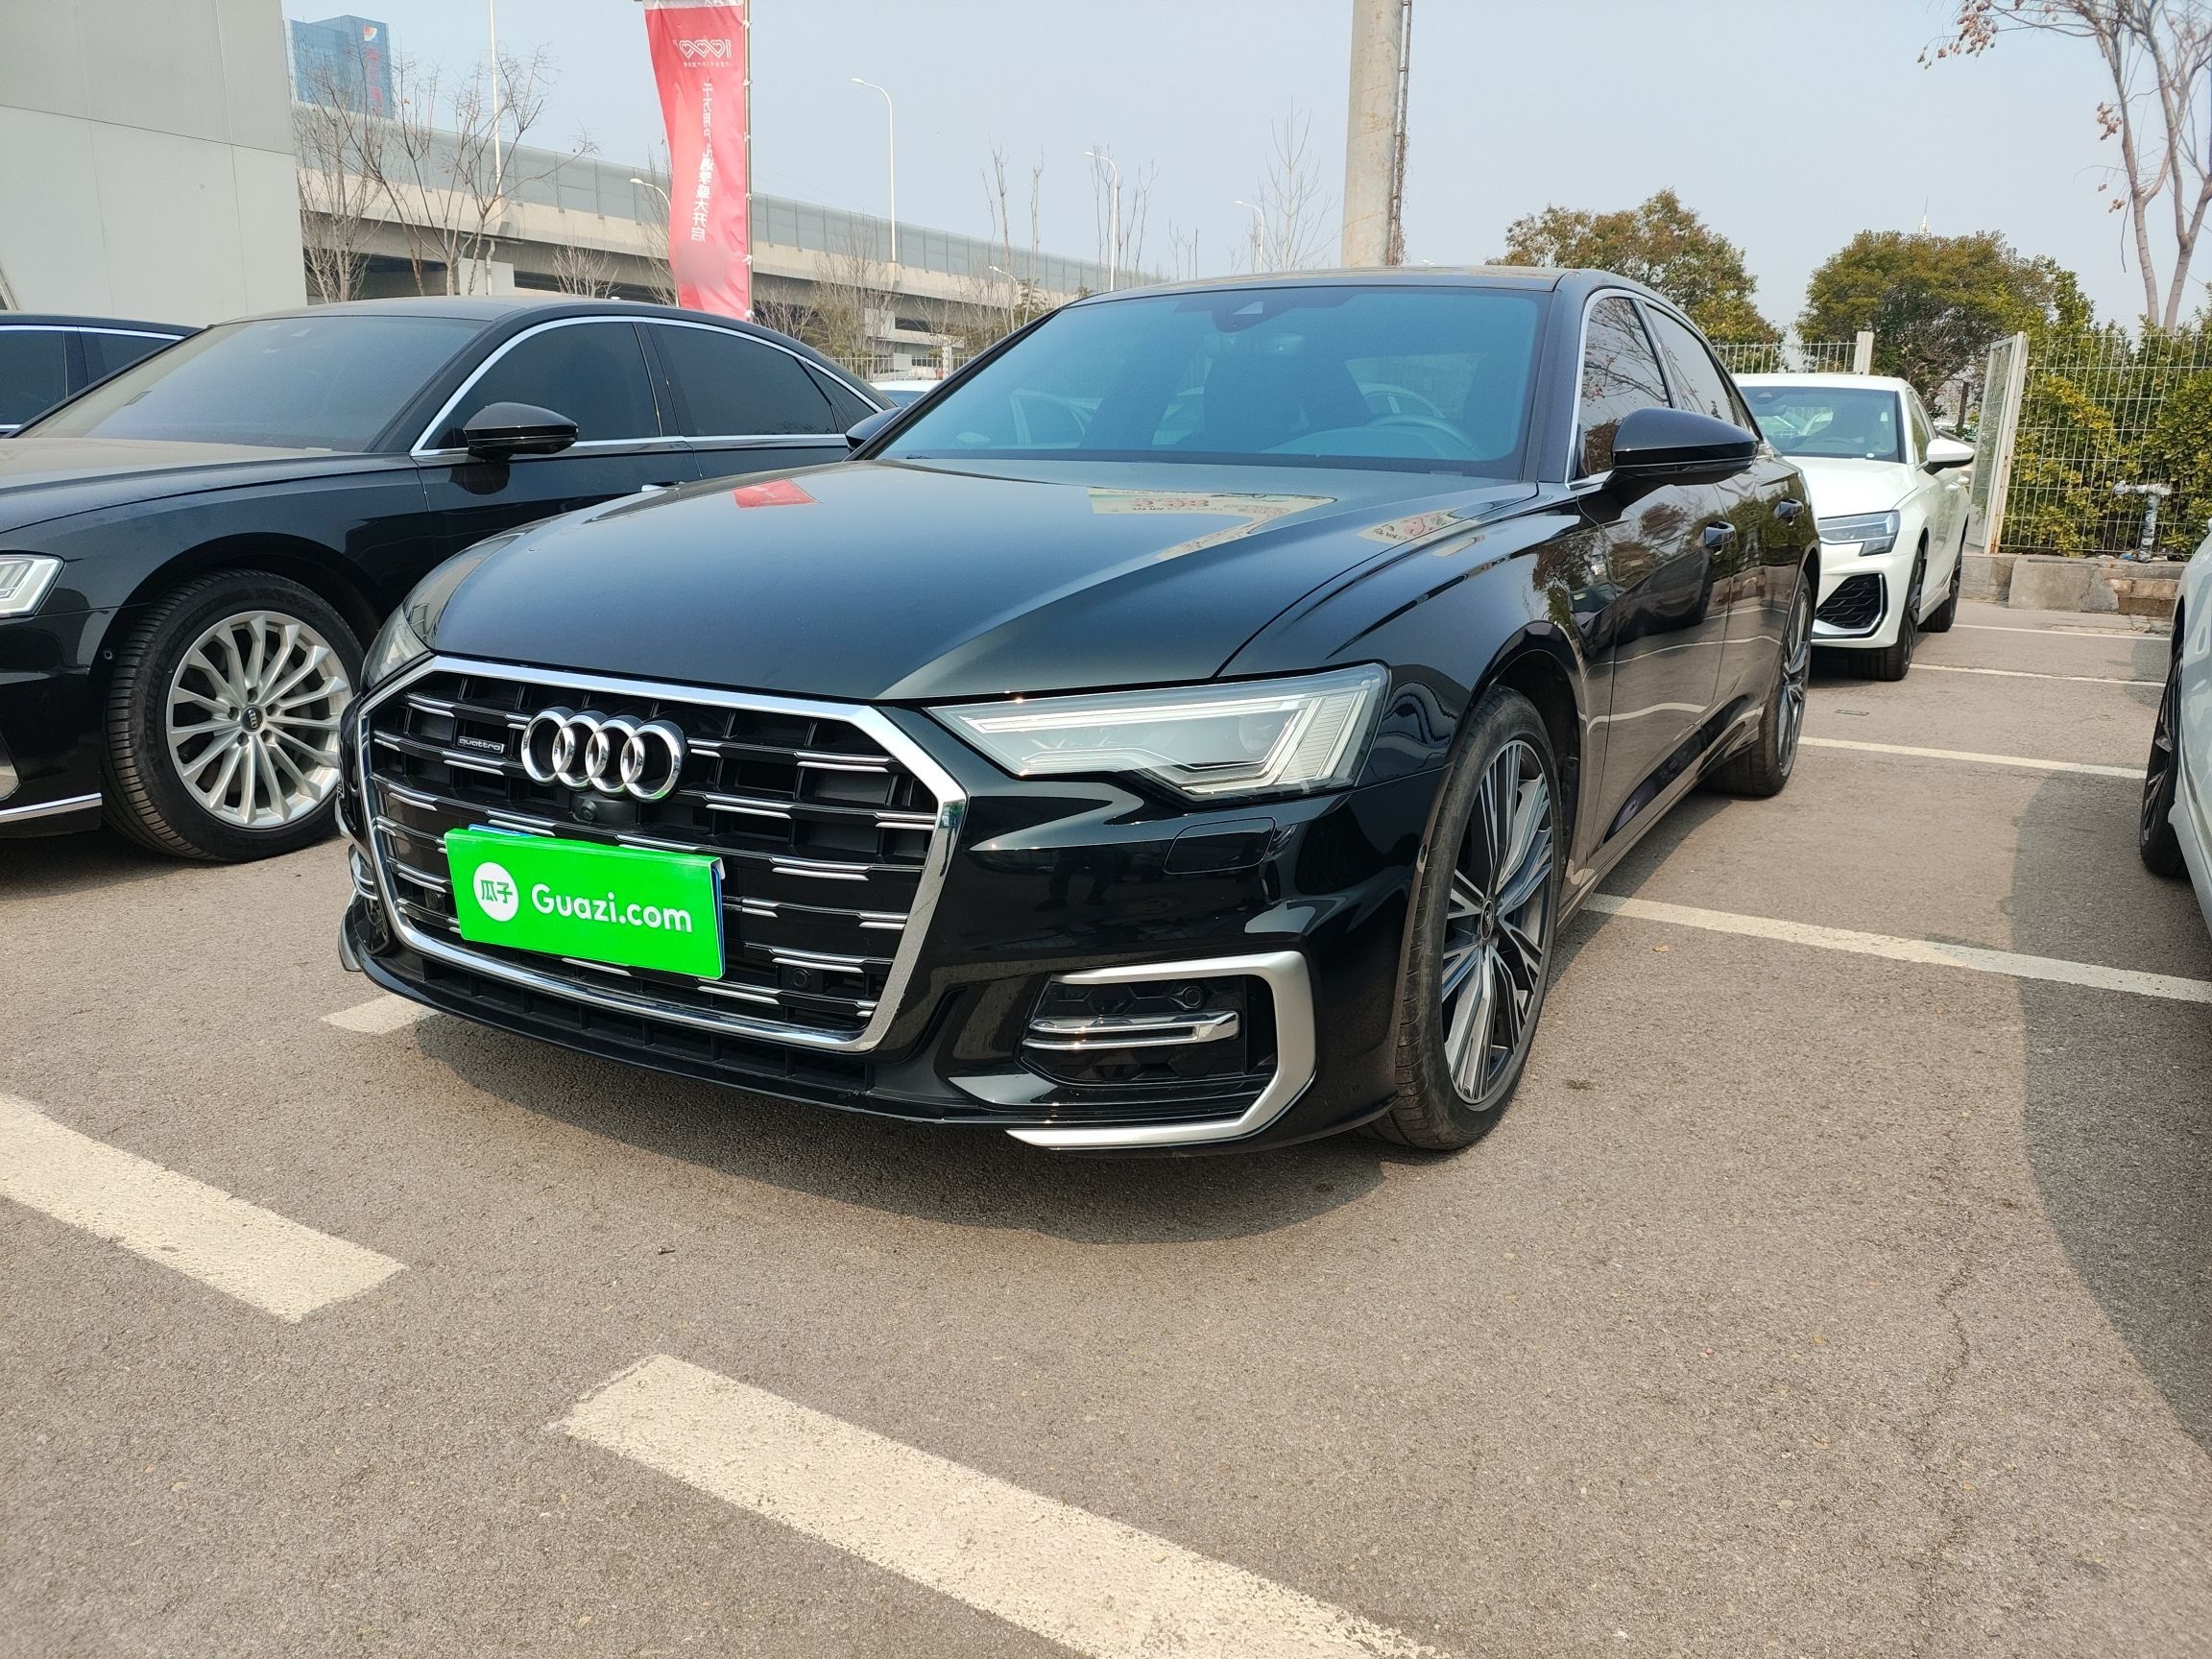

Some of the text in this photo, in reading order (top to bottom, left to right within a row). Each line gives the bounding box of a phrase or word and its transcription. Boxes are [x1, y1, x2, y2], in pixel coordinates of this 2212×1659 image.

[459, 738, 501, 751] quattro
[480, 878, 514, 904] 瓜子
[531, 883, 693, 933] Guazi.com
